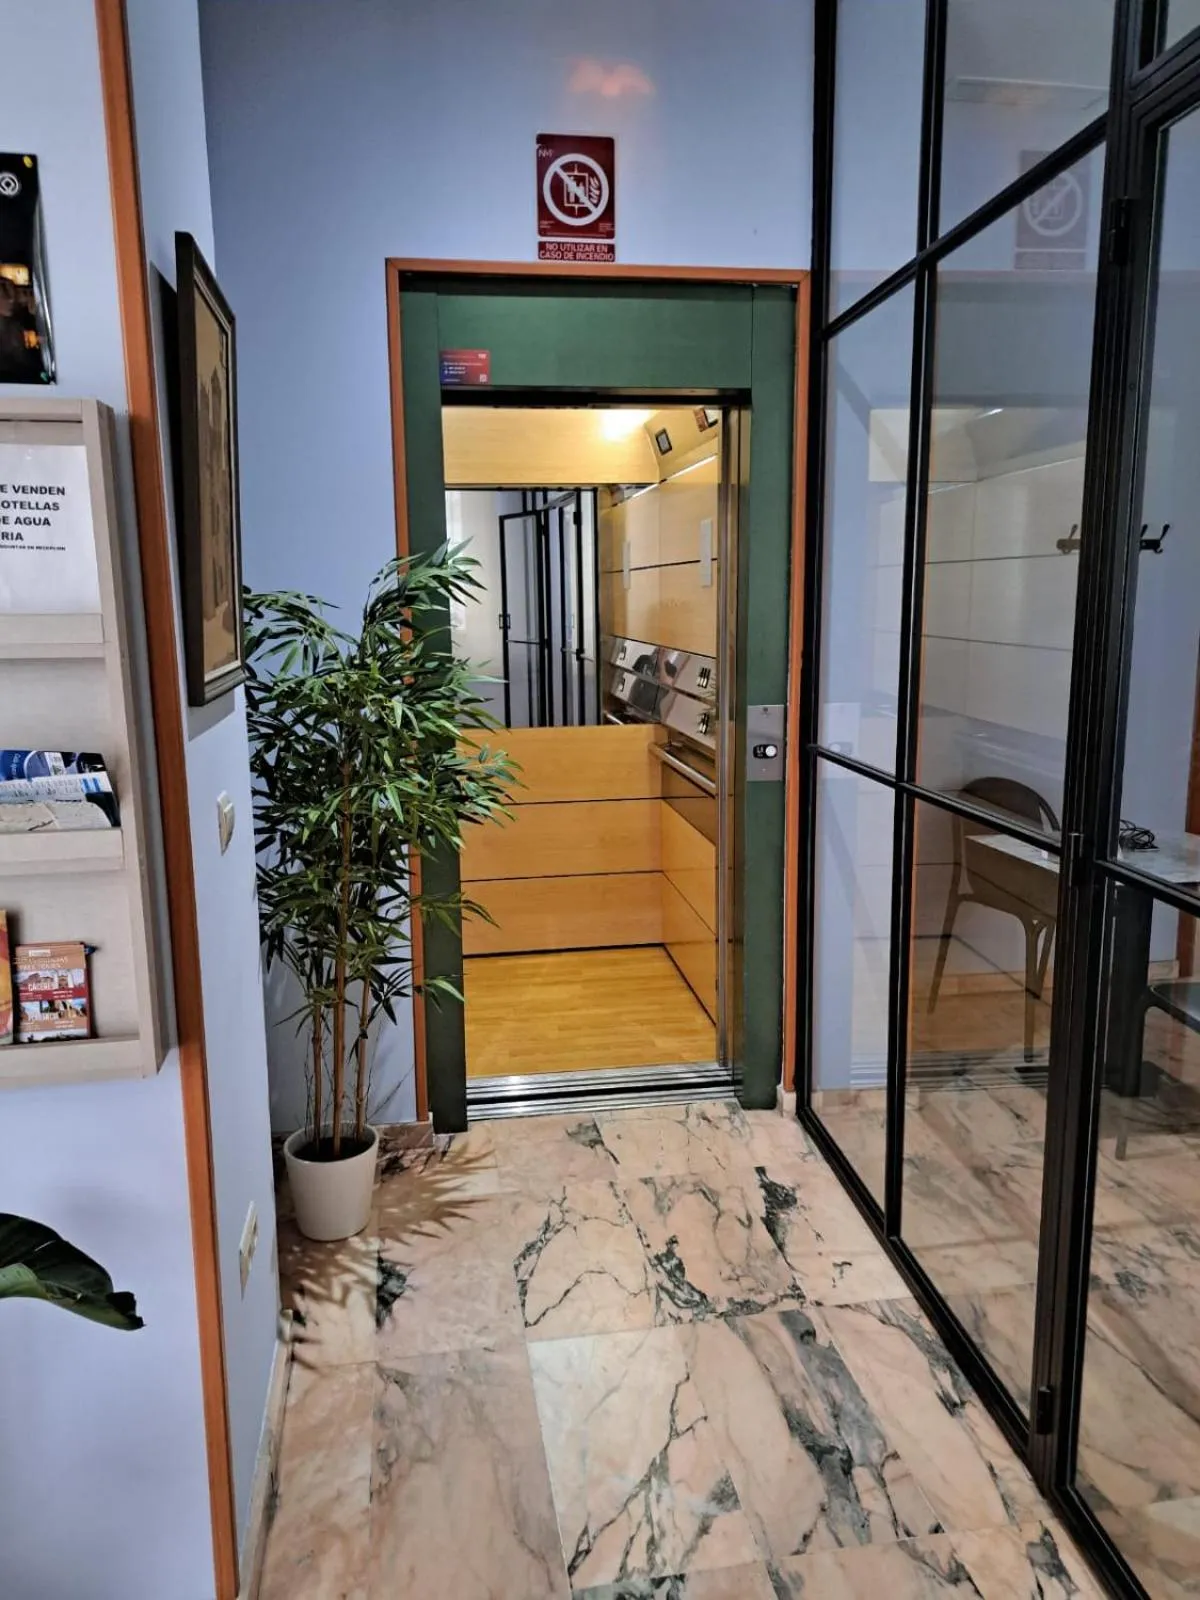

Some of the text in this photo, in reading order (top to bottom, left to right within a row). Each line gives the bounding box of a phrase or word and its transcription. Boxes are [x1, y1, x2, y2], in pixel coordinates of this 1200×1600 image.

[545, 243, 608, 253] NO UTILIZAR EN
[540, 250, 614, 260] CASO DE INCENDIO
[12, 484, 66, 496] VENDEN
[1, 500, 60, 511] OTELLAS
[0, 515, 51, 527] E AGUA
